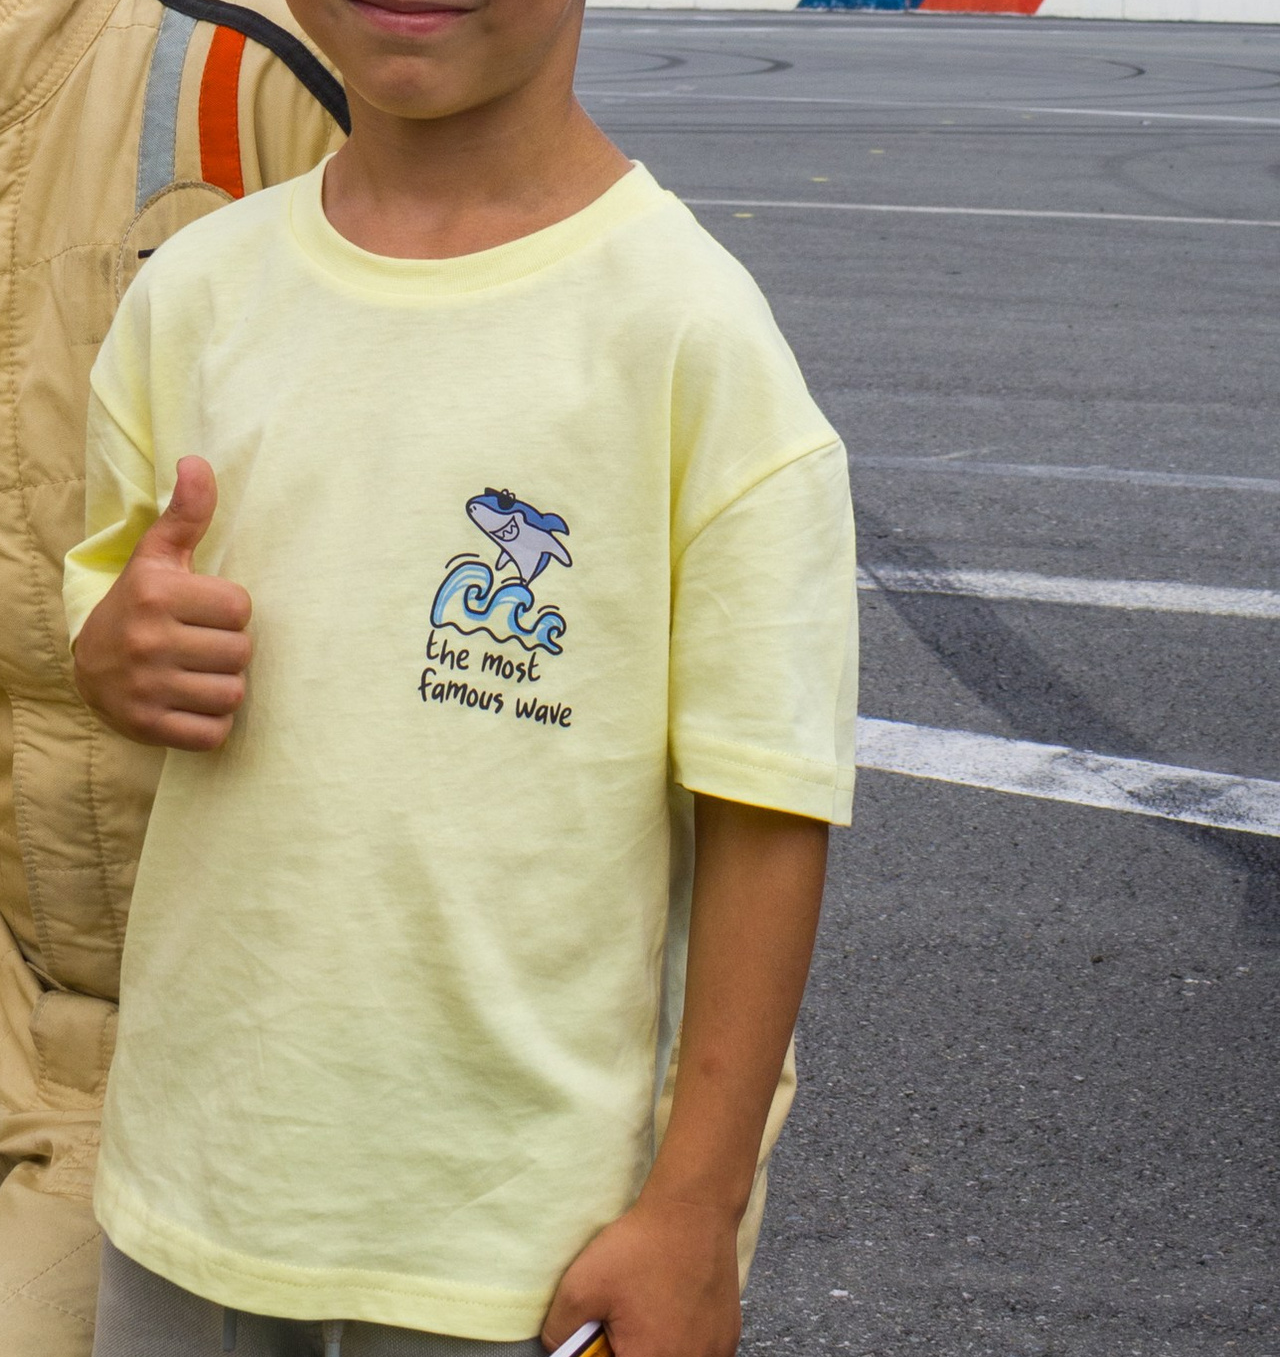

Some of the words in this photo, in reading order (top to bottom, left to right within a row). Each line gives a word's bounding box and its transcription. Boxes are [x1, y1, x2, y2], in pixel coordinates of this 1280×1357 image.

[426, 629, 469, 670] the
[481, 651, 541, 683] most
[418, 667, 504, 714] famous
[516, 697, 572, 727] wave
